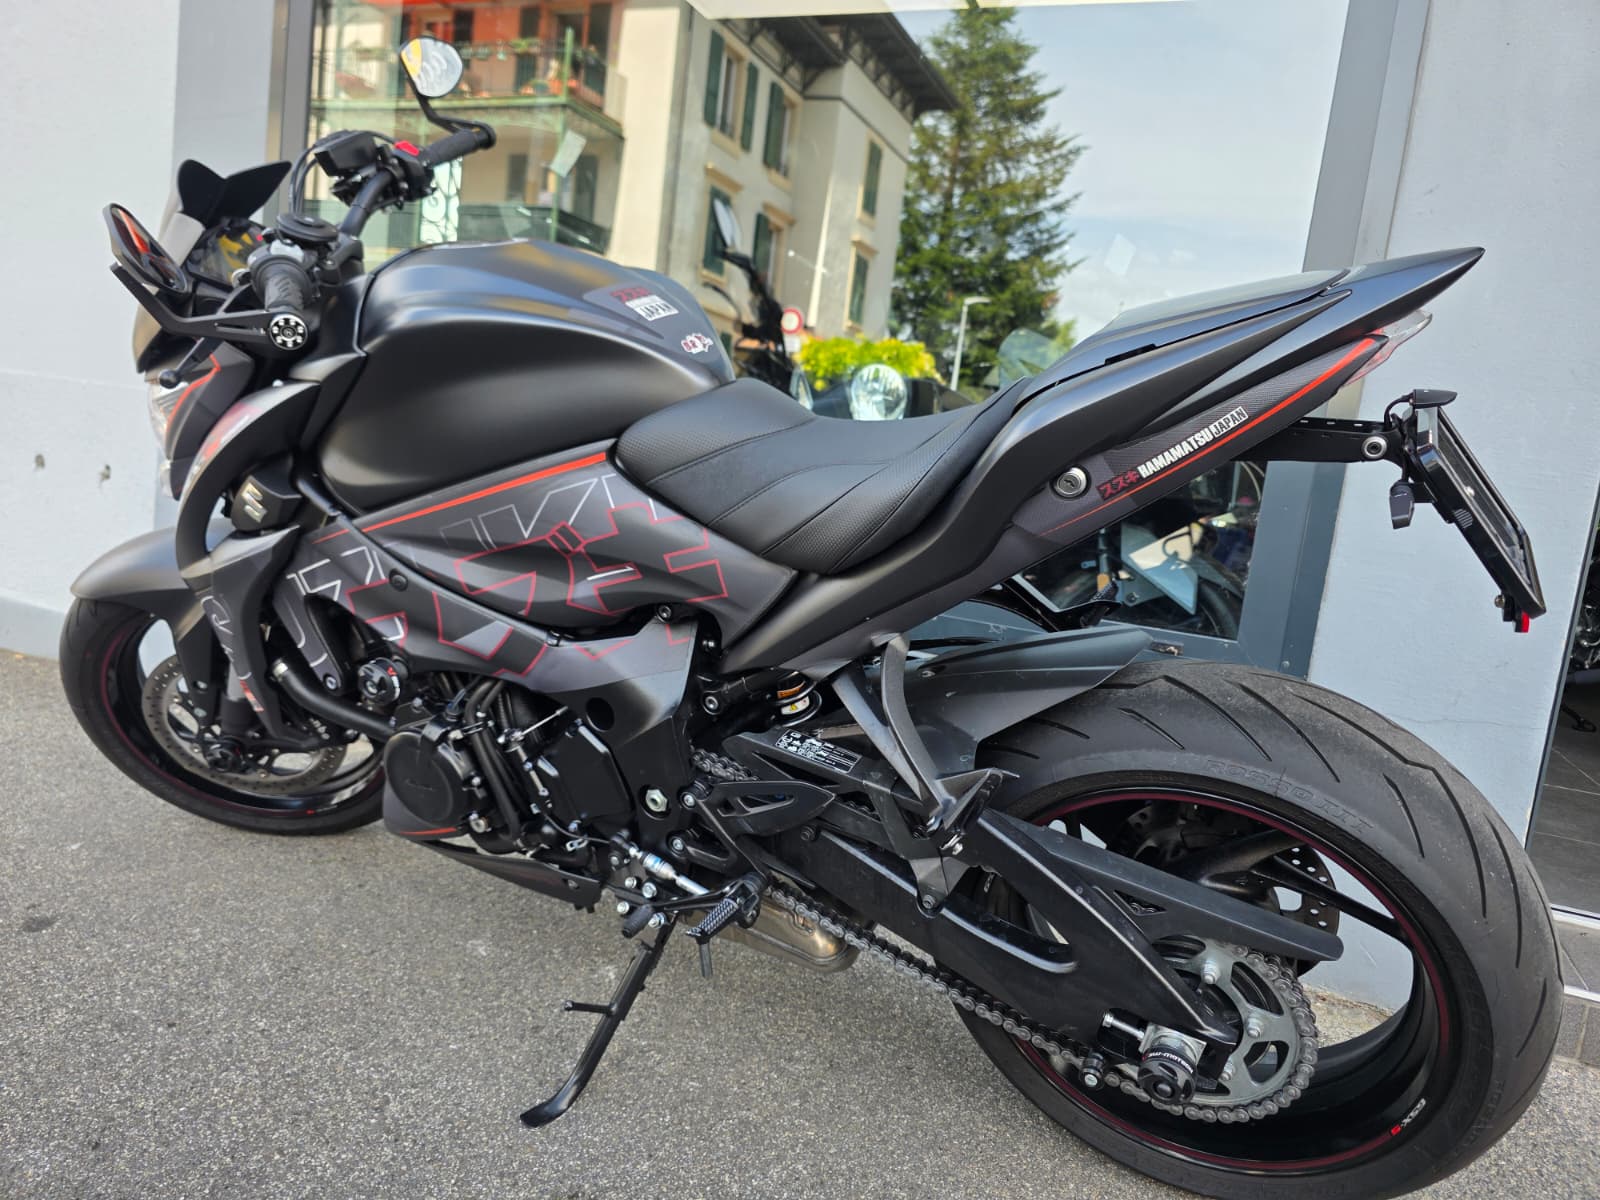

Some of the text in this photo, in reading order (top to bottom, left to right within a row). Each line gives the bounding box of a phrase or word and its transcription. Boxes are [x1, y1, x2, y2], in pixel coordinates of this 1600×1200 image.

[1099, 407, 1248, 498] スズキ HAMAMATSU JAPAN
